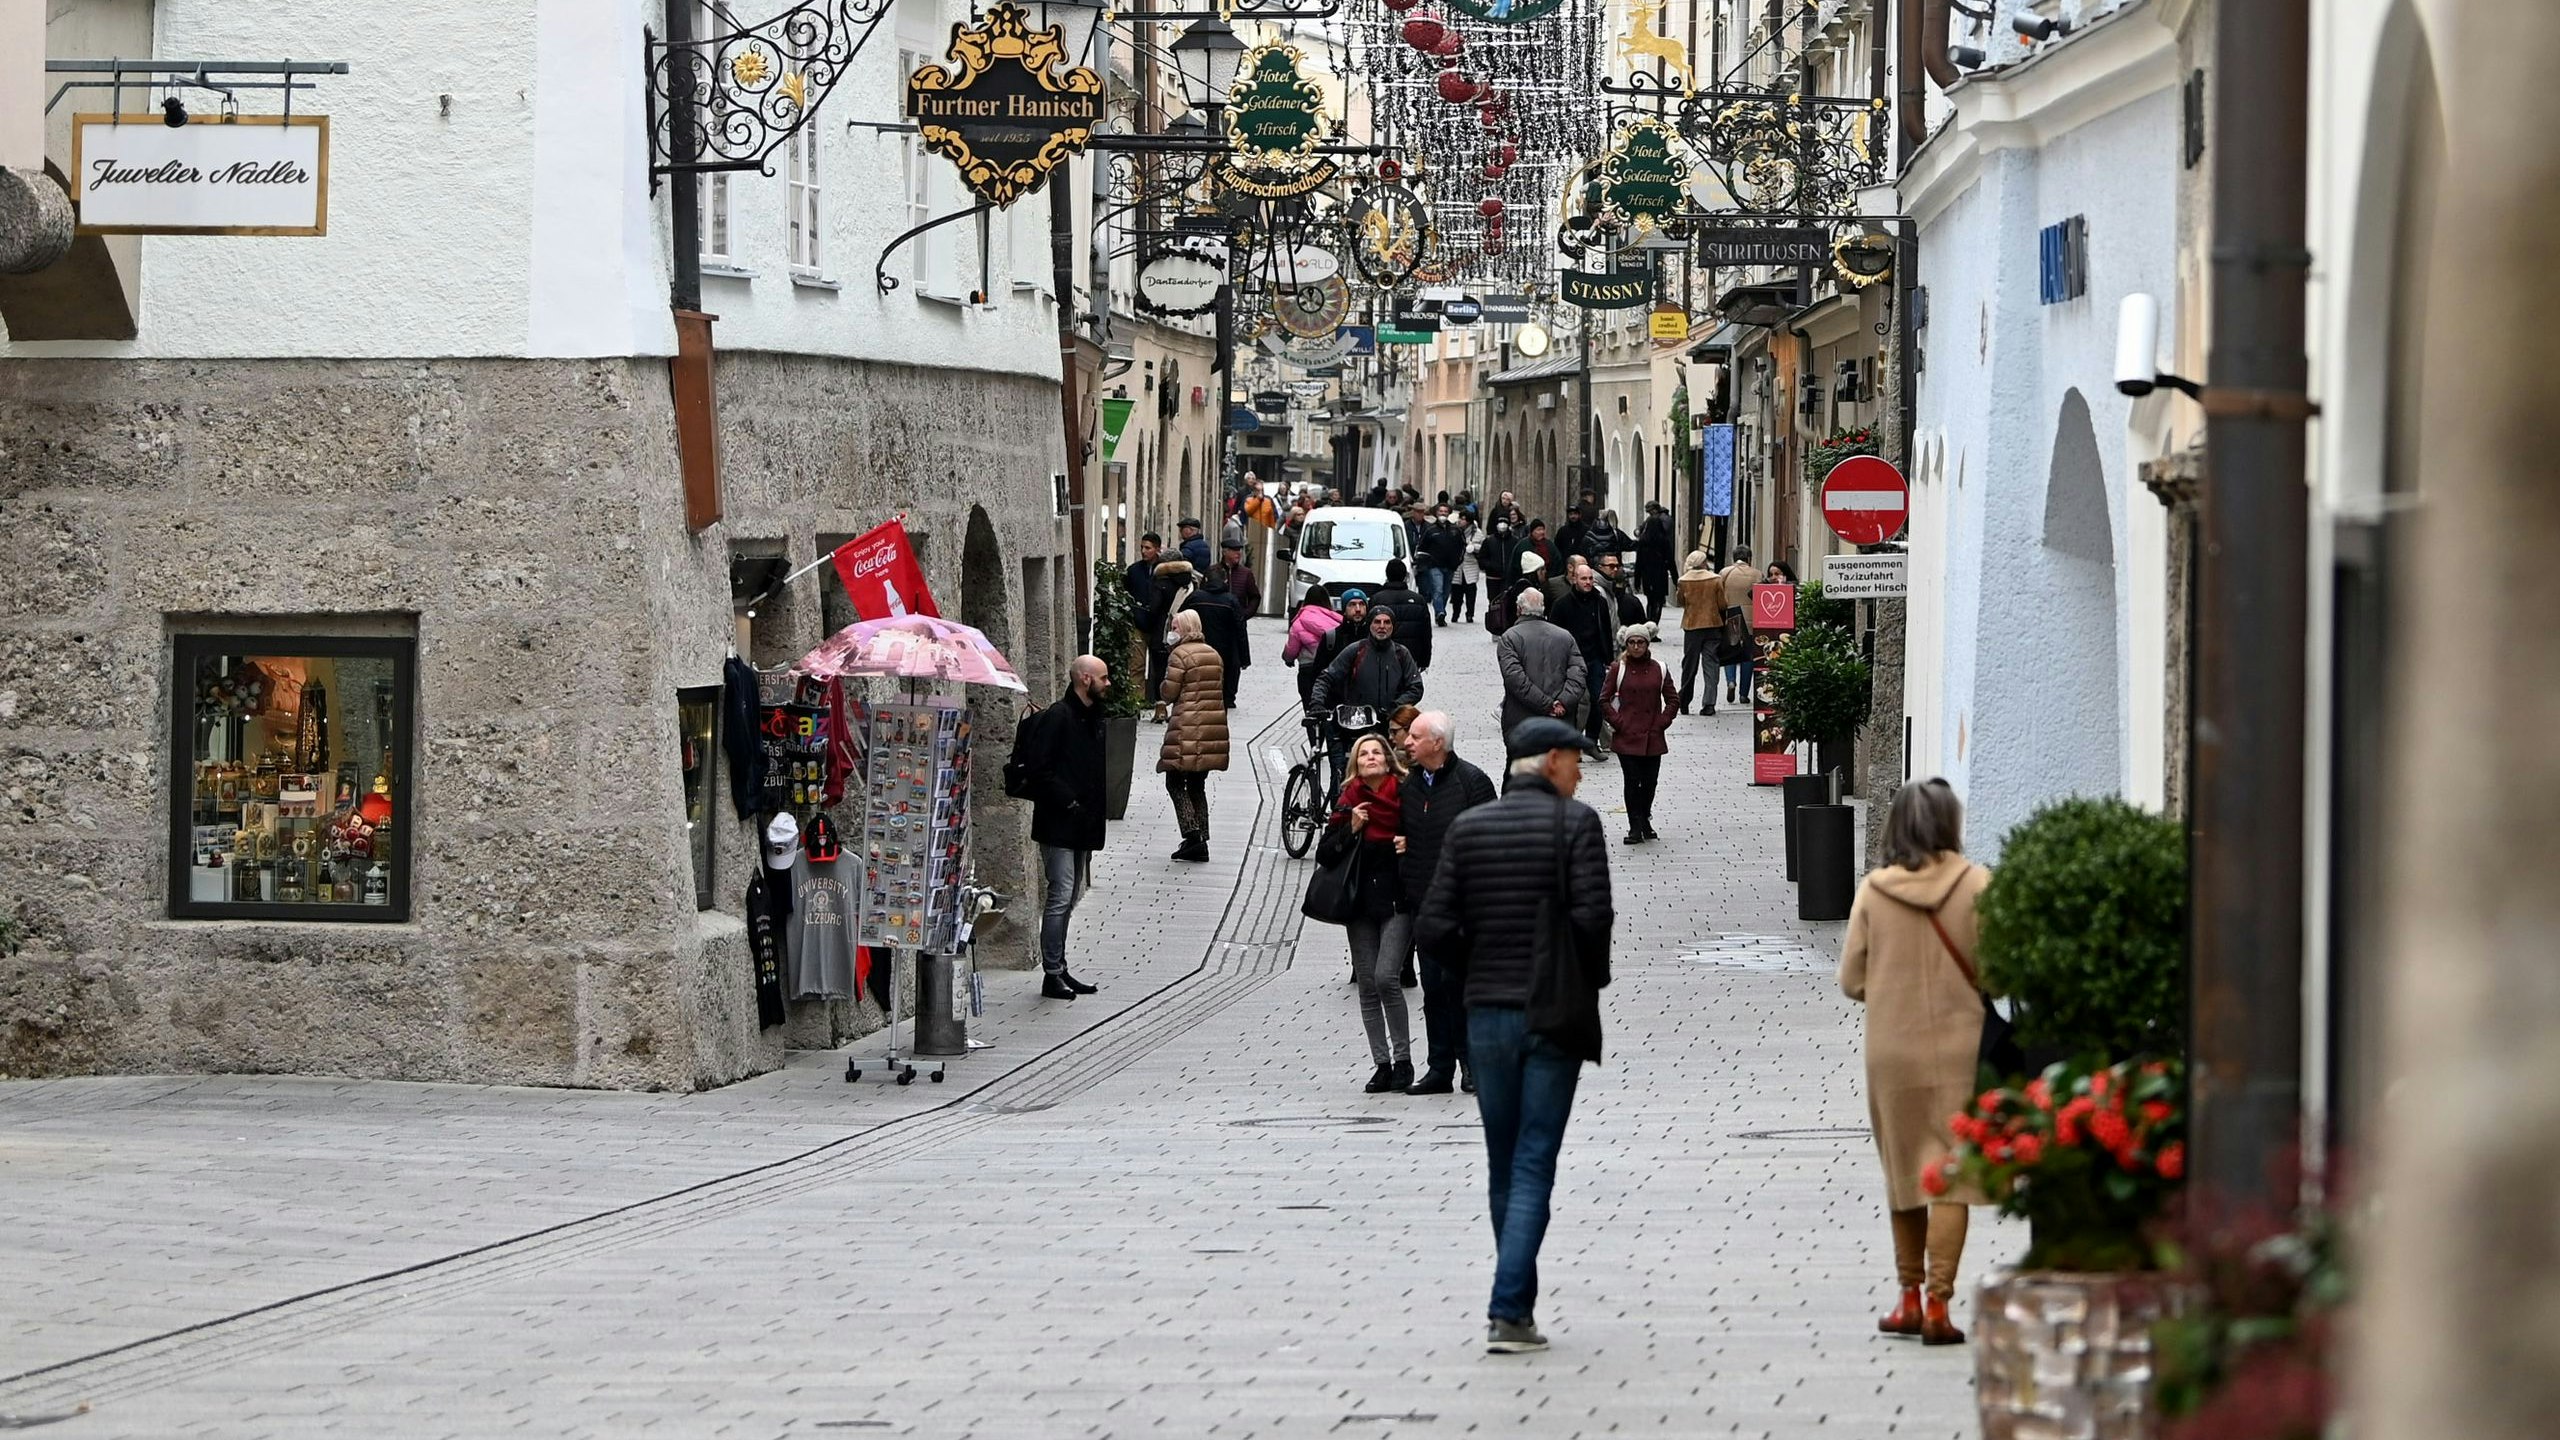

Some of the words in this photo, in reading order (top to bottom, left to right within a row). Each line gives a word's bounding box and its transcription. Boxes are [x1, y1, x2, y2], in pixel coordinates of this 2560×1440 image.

[1256, 69, 1293, 82] Hotel
[917, 93, 1000, 116] Furtner
[1008, 94, 1094, 117] Hanisch
[1249, 95, 1304, 111] Goldener
[1254, 122, 1297, 136] Hirsch
[980, 132, 1000, 143] seit
[1001, 132, 1032, 143] 1955
[1632, 144, 1665, 158] Hotel
[90, 159, 203, 191] Juwelier
[209, 160, 310, 184] Nadler
[1217, 162, 1334, 197] Kupferschmiedhaus
[1623, 169, 1671, 183] Goldener
[1627, 194, 1664, 207] Hirsch
[1708, 243, 1821, 260] SPIRITUOSEN
[1145, 275, 1213, 288] Dantendorfer
[1569, 280, 1644, 300] STASSNY
[1400, 311, 1439, 320] SWAROVSKI
[1279, 350, 1344, 365] Aschauer
[853, 546, 871, 558] Enjoy
[872, 538, 886, 550] your
[1828, 561, 1903, 570] ausgenommen
[1838, 572, 1894, 581] Taxizufahrt
[1825, 584, 1872, 593] Goldener
[1874, 583, 1907, 592] Hirsch
[798, 877, 848, 899] UNIVERSITY
